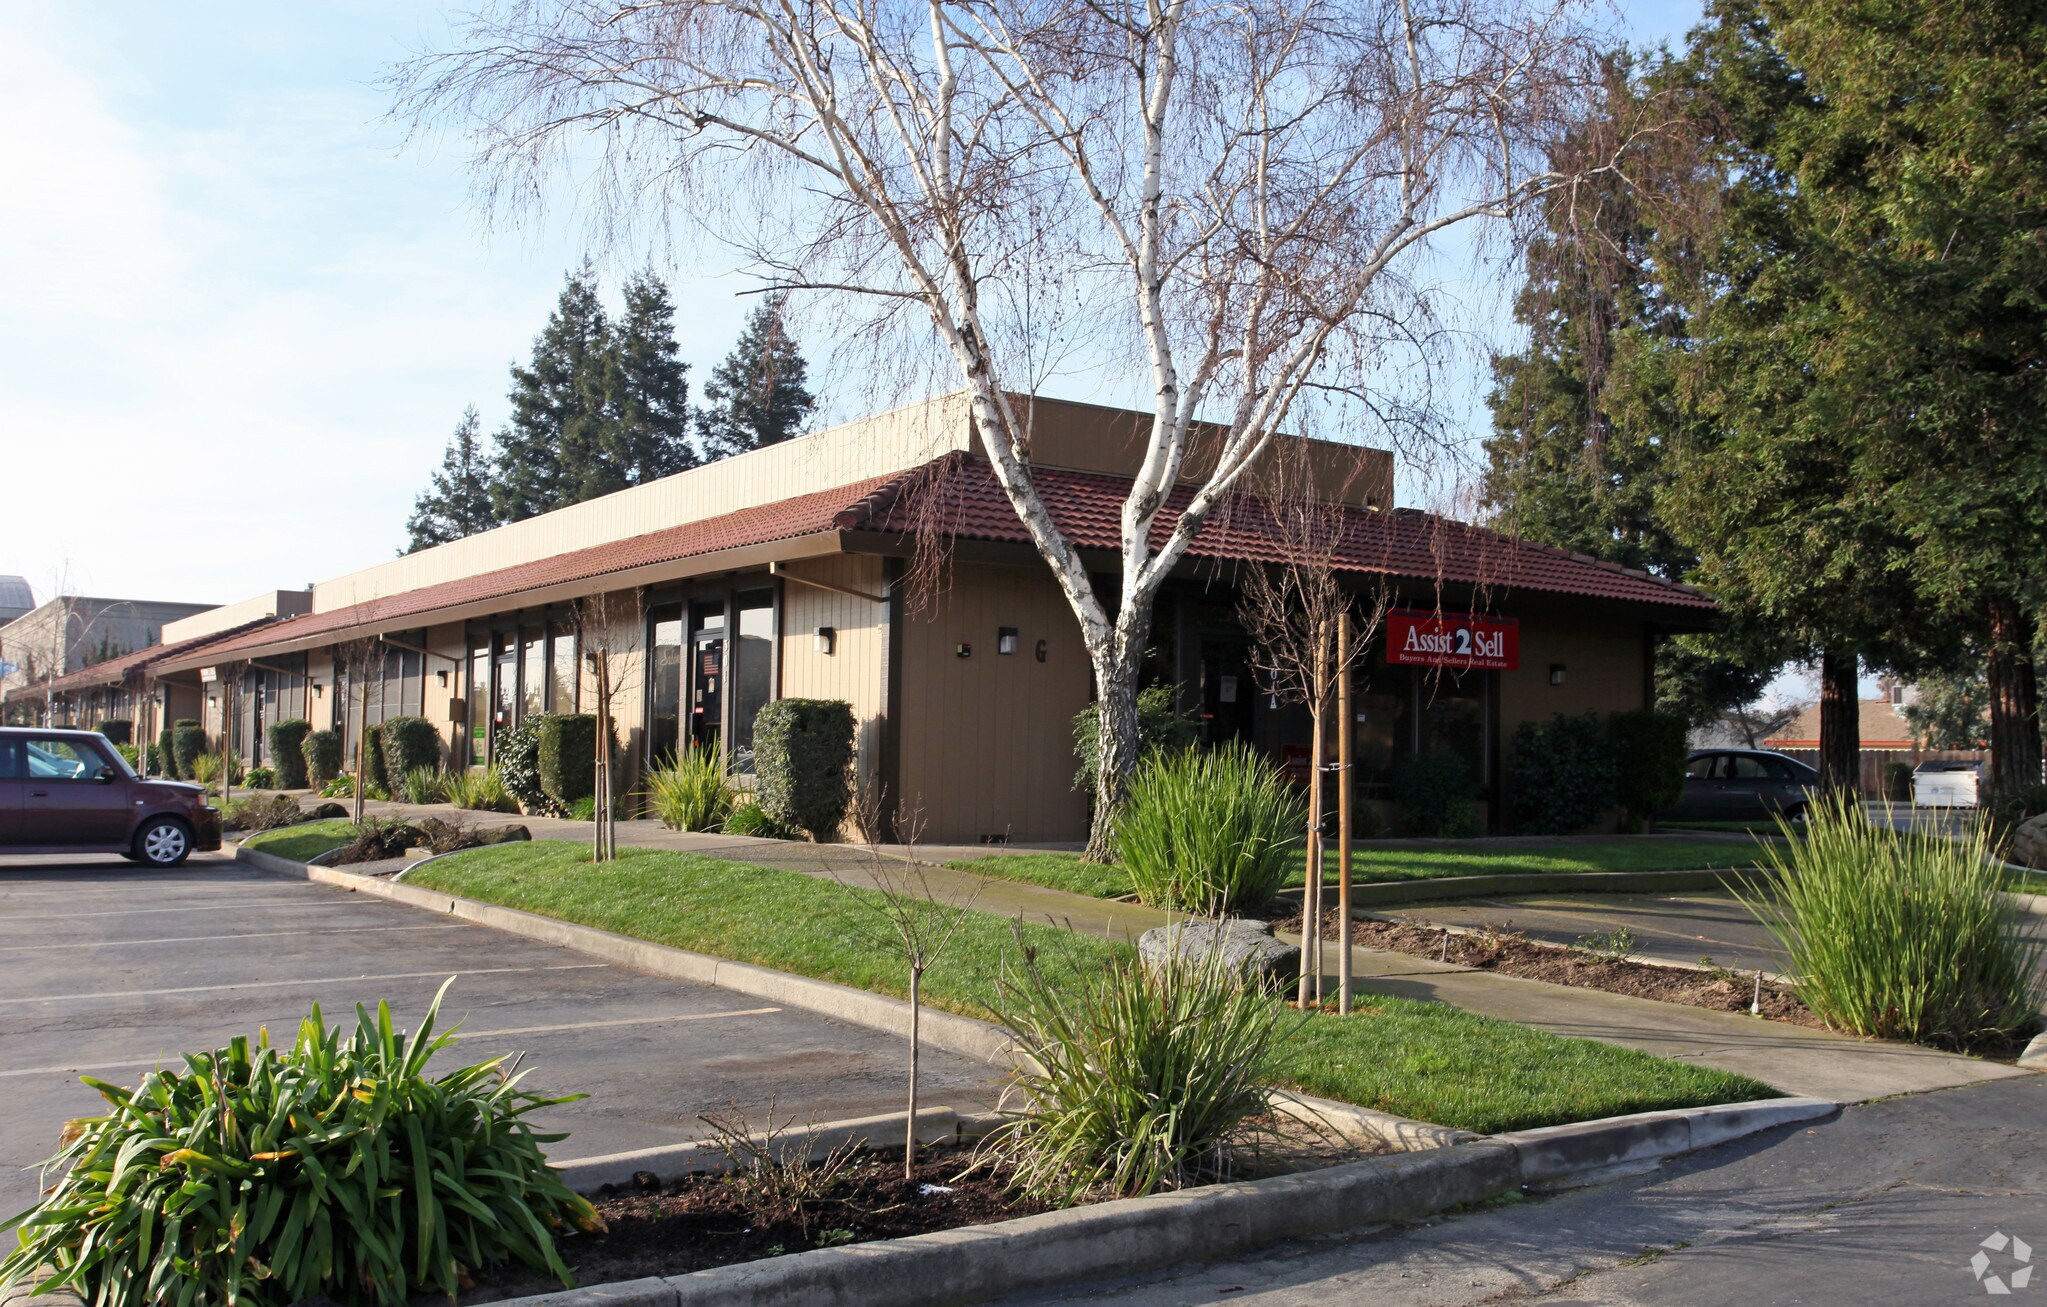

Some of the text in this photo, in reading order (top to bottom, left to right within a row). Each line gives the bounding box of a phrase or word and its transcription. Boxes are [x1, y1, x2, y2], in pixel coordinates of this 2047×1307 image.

[1035, 639, 1048, 663] G
[1404, 625, 1504, 657] Assist 2 Sell
[1400, 653, 1425, 662] Buyers
[1443, 656, 1468, 665] Sellers
[1486, 659, 1508, 667] Estate
